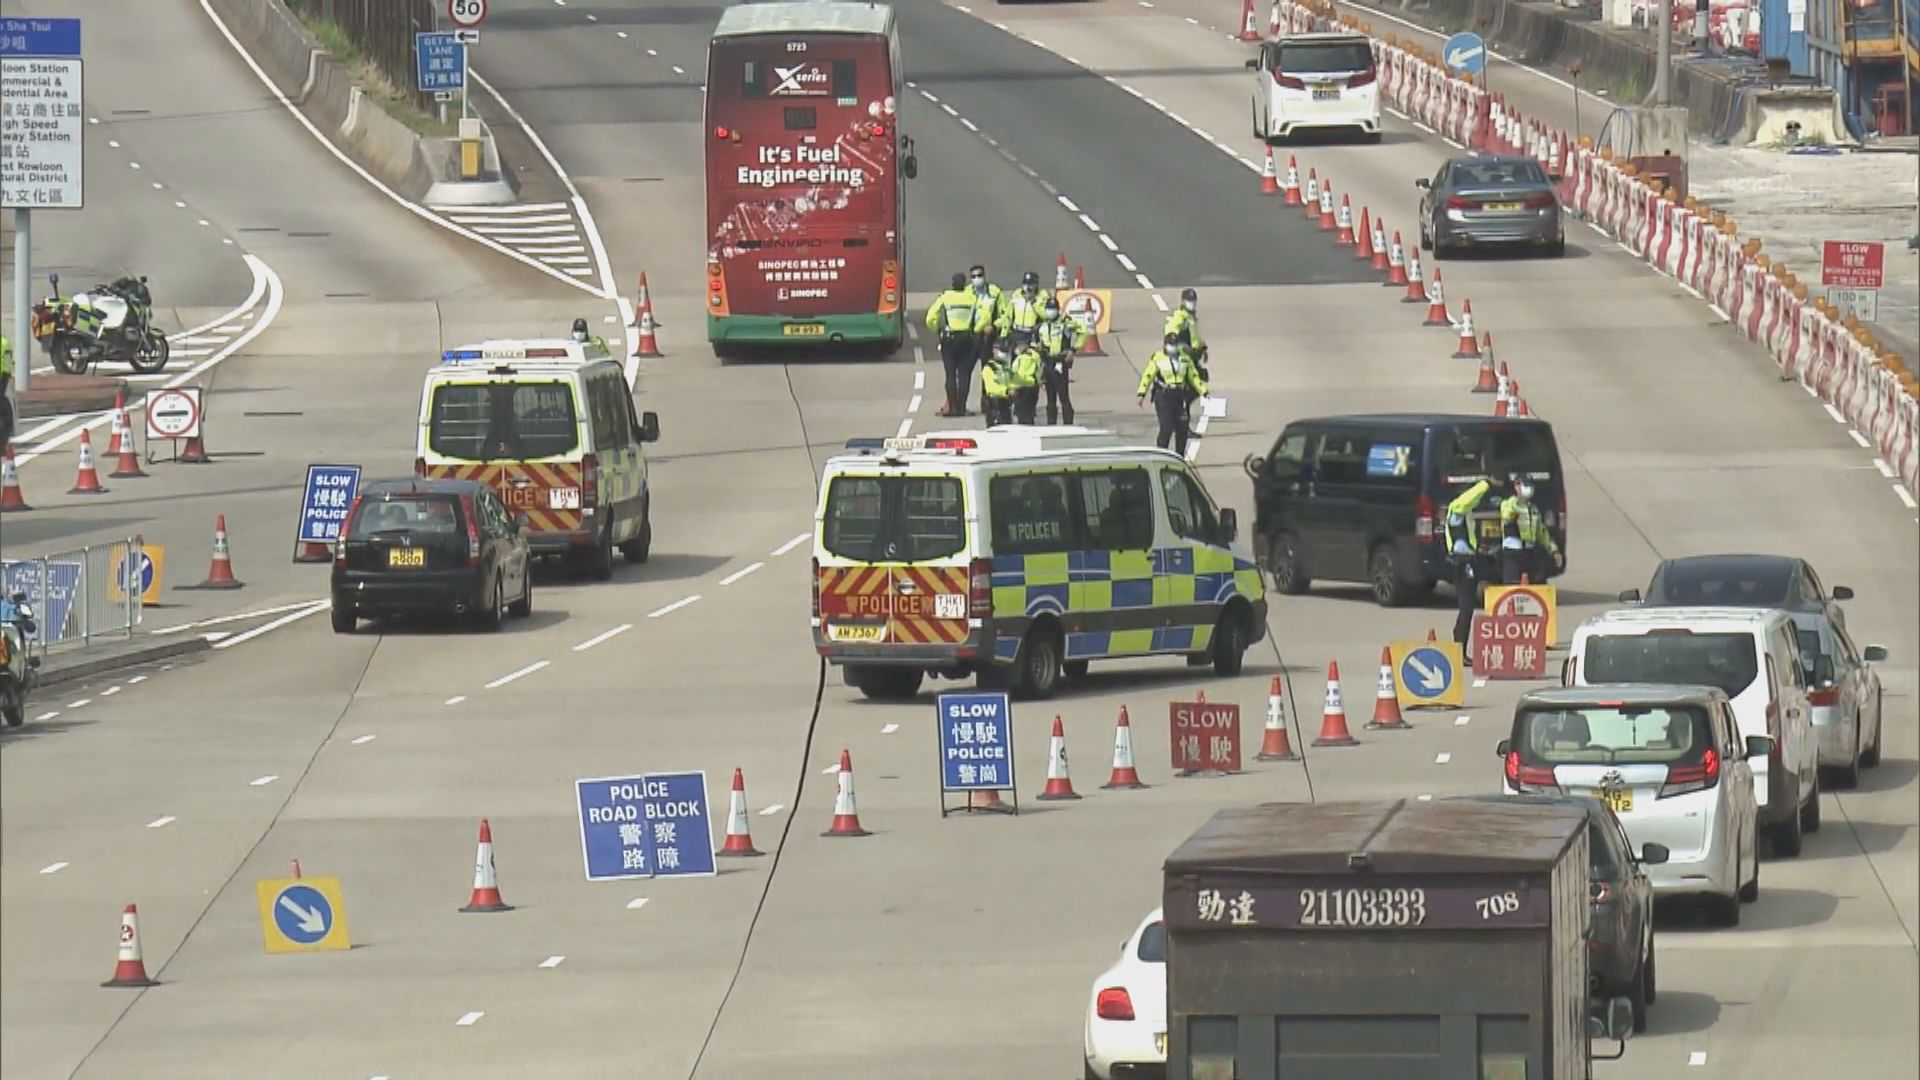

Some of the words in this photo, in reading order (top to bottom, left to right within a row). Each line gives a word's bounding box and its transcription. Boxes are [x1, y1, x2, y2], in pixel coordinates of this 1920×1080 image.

[456, 0, 480, 15] 50
[6, 20, 27, 31] Sha
[31, 20, 52, 32] Tsui
[429, 46, 454, 55] LANE
[786, 42, 807, 52] 5723
[30, 64, 69, 73] Station
[796, 67, 828, 82] series
[54, 78, 62, 87] &
[44, 88, 68, 98] Area
[23, 119, 58, 129] Speed
[29, 132, 71, 141] Station
[759, 145, 792, 163] It's
[797, 143, 840, 163] Fuel
[17, 162, 63, 171] Kowloon
[29, 173, 68, 182] District
[737, 165, 864, 188] Engineering
[1839, 243, 1869, 254] SLOW
[790, 288, 829, 298] SINOPEC
[1838, 291, 1857, 302] 100
[315, 474, 352, 487] SLOW
[313, 488, 348, 508] 慢駛
[307, 508, 349, 520] POLICE
[1018, 521, 1050, 540] POLICE
[860, 596, 919, 614] POLICE
[853, 624, 878, 637] 7367
[1481, 621, 1540, 639] SLOW
[1481, 644, 1537, 670] 慢駛
[949, 703, 997, 717] SLOW
[1177, 709, 1233, 729] SLOW
[951, 721, 999, 745] 慢駛
[948, 746, 1004, 760] POLICE
[1179, 735, 1233, 764] 慢駛
[610, 781, 669, 803] POLICE
[589, 804, 638, 824] ROAD
[645, 799, 700, 819] BLOCK
[618, 821, 677, 846] 警察
[622, 846, 680, 870] 路障
[1300, 888, 1426, 926] 21103333
[1475, 891, 1520, 920] 708
